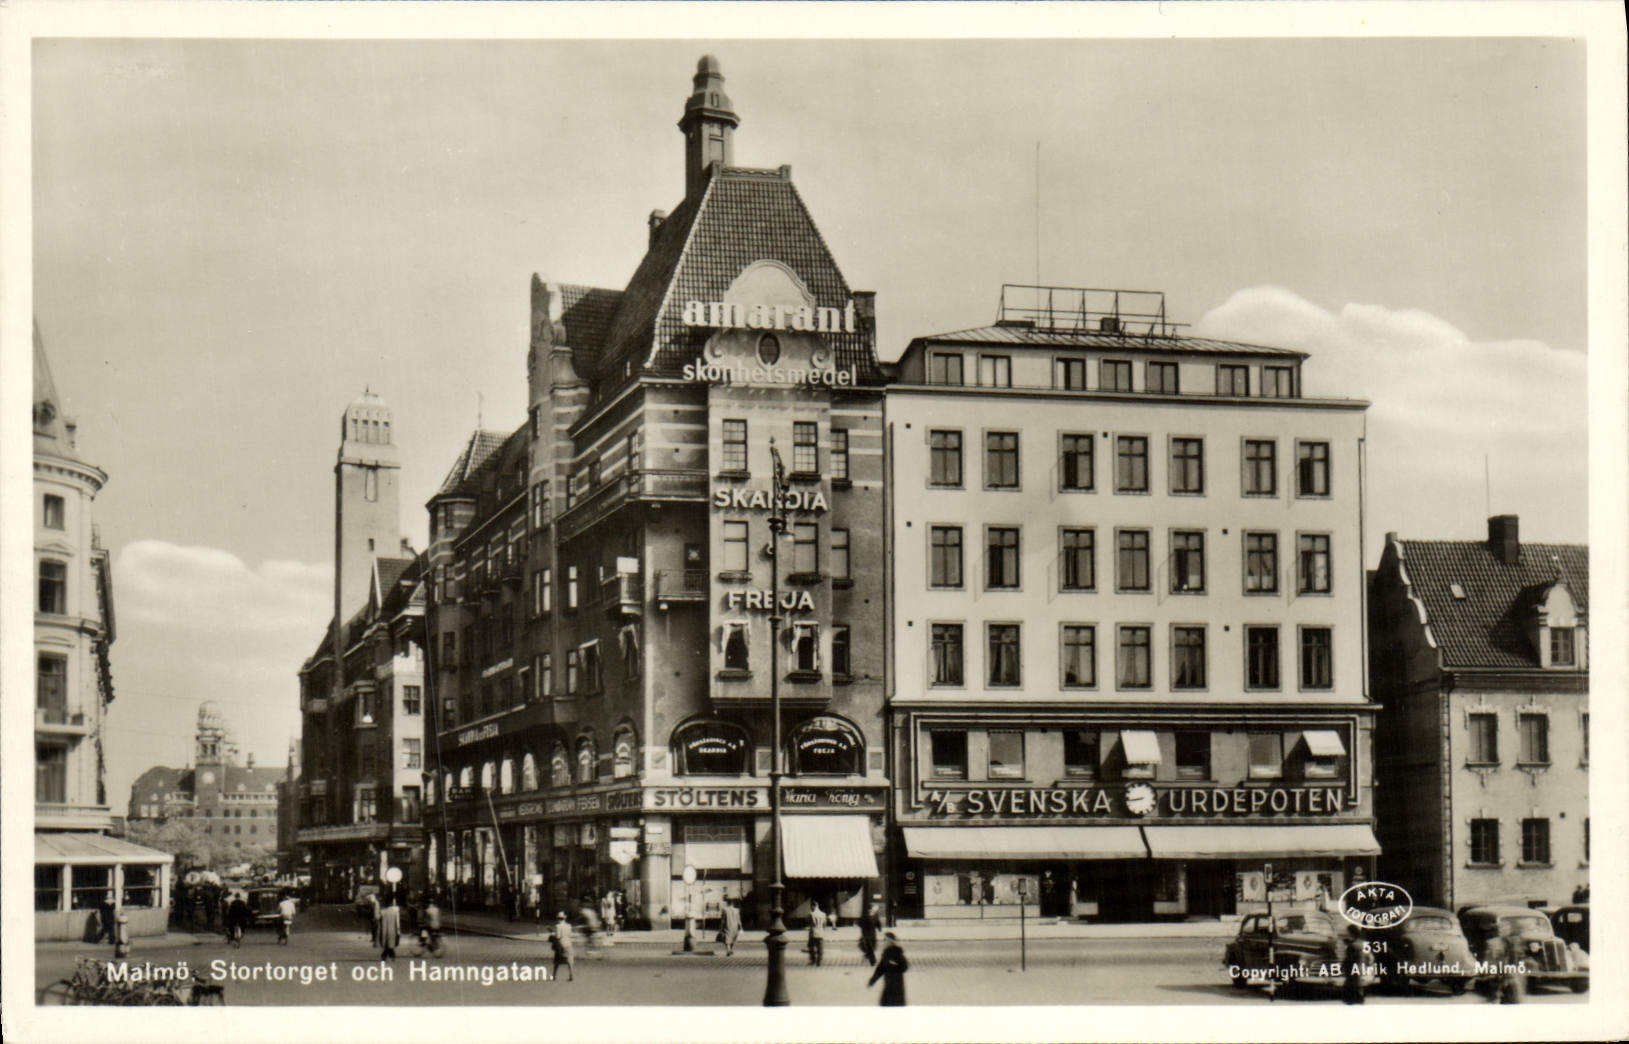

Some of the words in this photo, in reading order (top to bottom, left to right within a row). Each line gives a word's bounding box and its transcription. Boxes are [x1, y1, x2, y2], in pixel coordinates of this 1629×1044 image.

[682, 299, 857, 333] amarant
[728, 590, 815, 610] FREJA
[654, 787, 759, 807] STÖLTENS
[967, 790, 1112, 813] SVENSKA
[1169, 788, 1342, 813] URDEPOTEN
